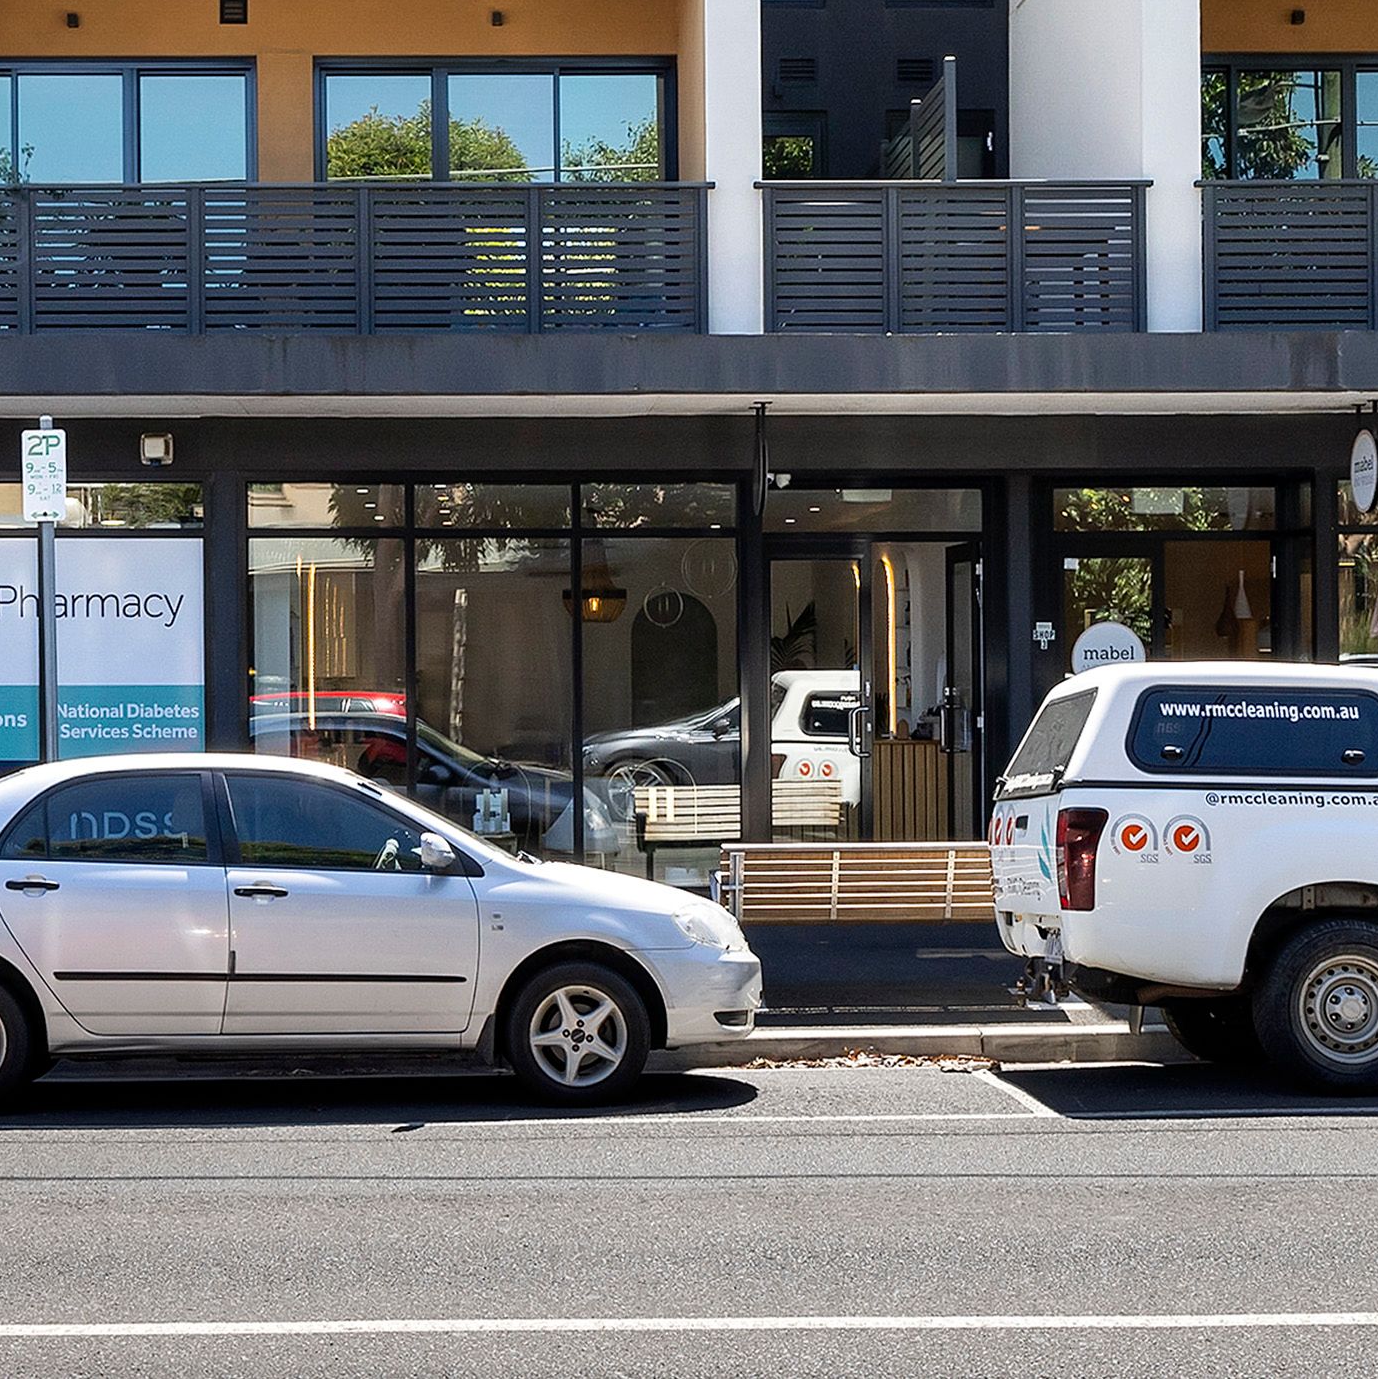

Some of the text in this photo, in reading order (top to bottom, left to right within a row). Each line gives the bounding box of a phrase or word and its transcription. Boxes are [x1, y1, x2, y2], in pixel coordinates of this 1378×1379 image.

[27, 434, 61, 456] 2P
[1084, 646, 1135, 660] mabel
[58, 704, 199, 719] National Diabetes
[1160, 701, 1360, 722] www.rmccleaning.com.au
[60, 724, 198, 739] Services Scheme
[1141, 854, 1159, 863] SGS
[1194, 854, 1212, 864] SGS
